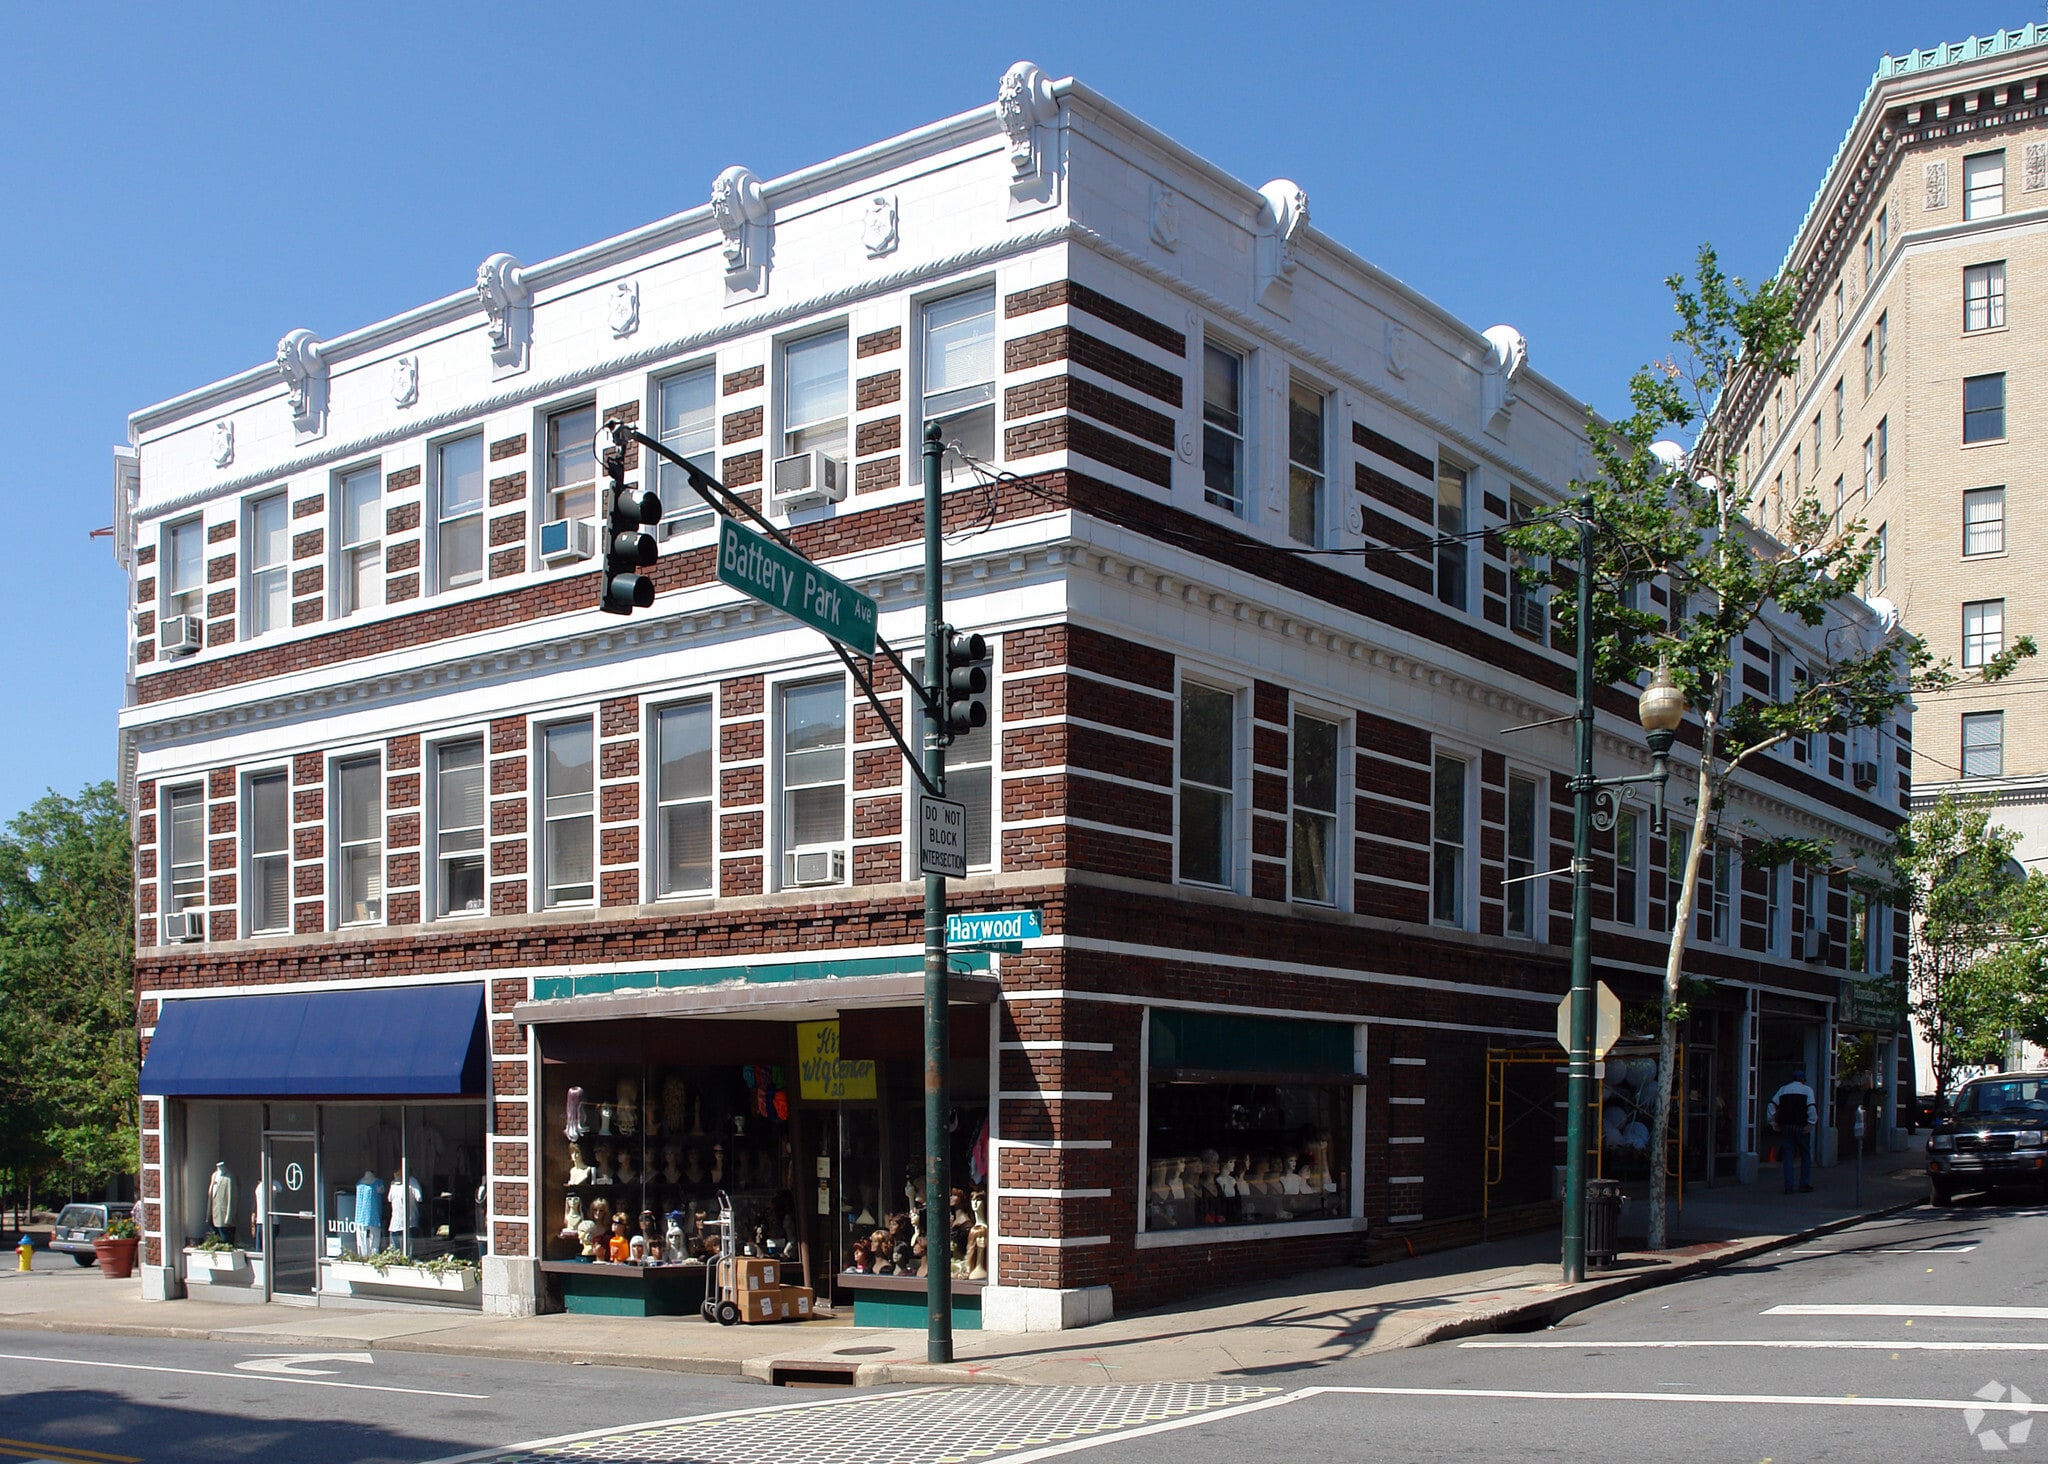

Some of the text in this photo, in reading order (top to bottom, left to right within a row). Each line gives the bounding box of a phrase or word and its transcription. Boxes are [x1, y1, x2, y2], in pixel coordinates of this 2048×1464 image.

[725, 528, 872, 626] Battery Park Ave
[925, 805, 961, 826] DO NOT
[929, 827, 958, 847] BLOCK
[922, 848, 965, 870] INTERSECTION
[950, 914, 1022, 941] Haywood
[328, 1217, 364, 1234] union
